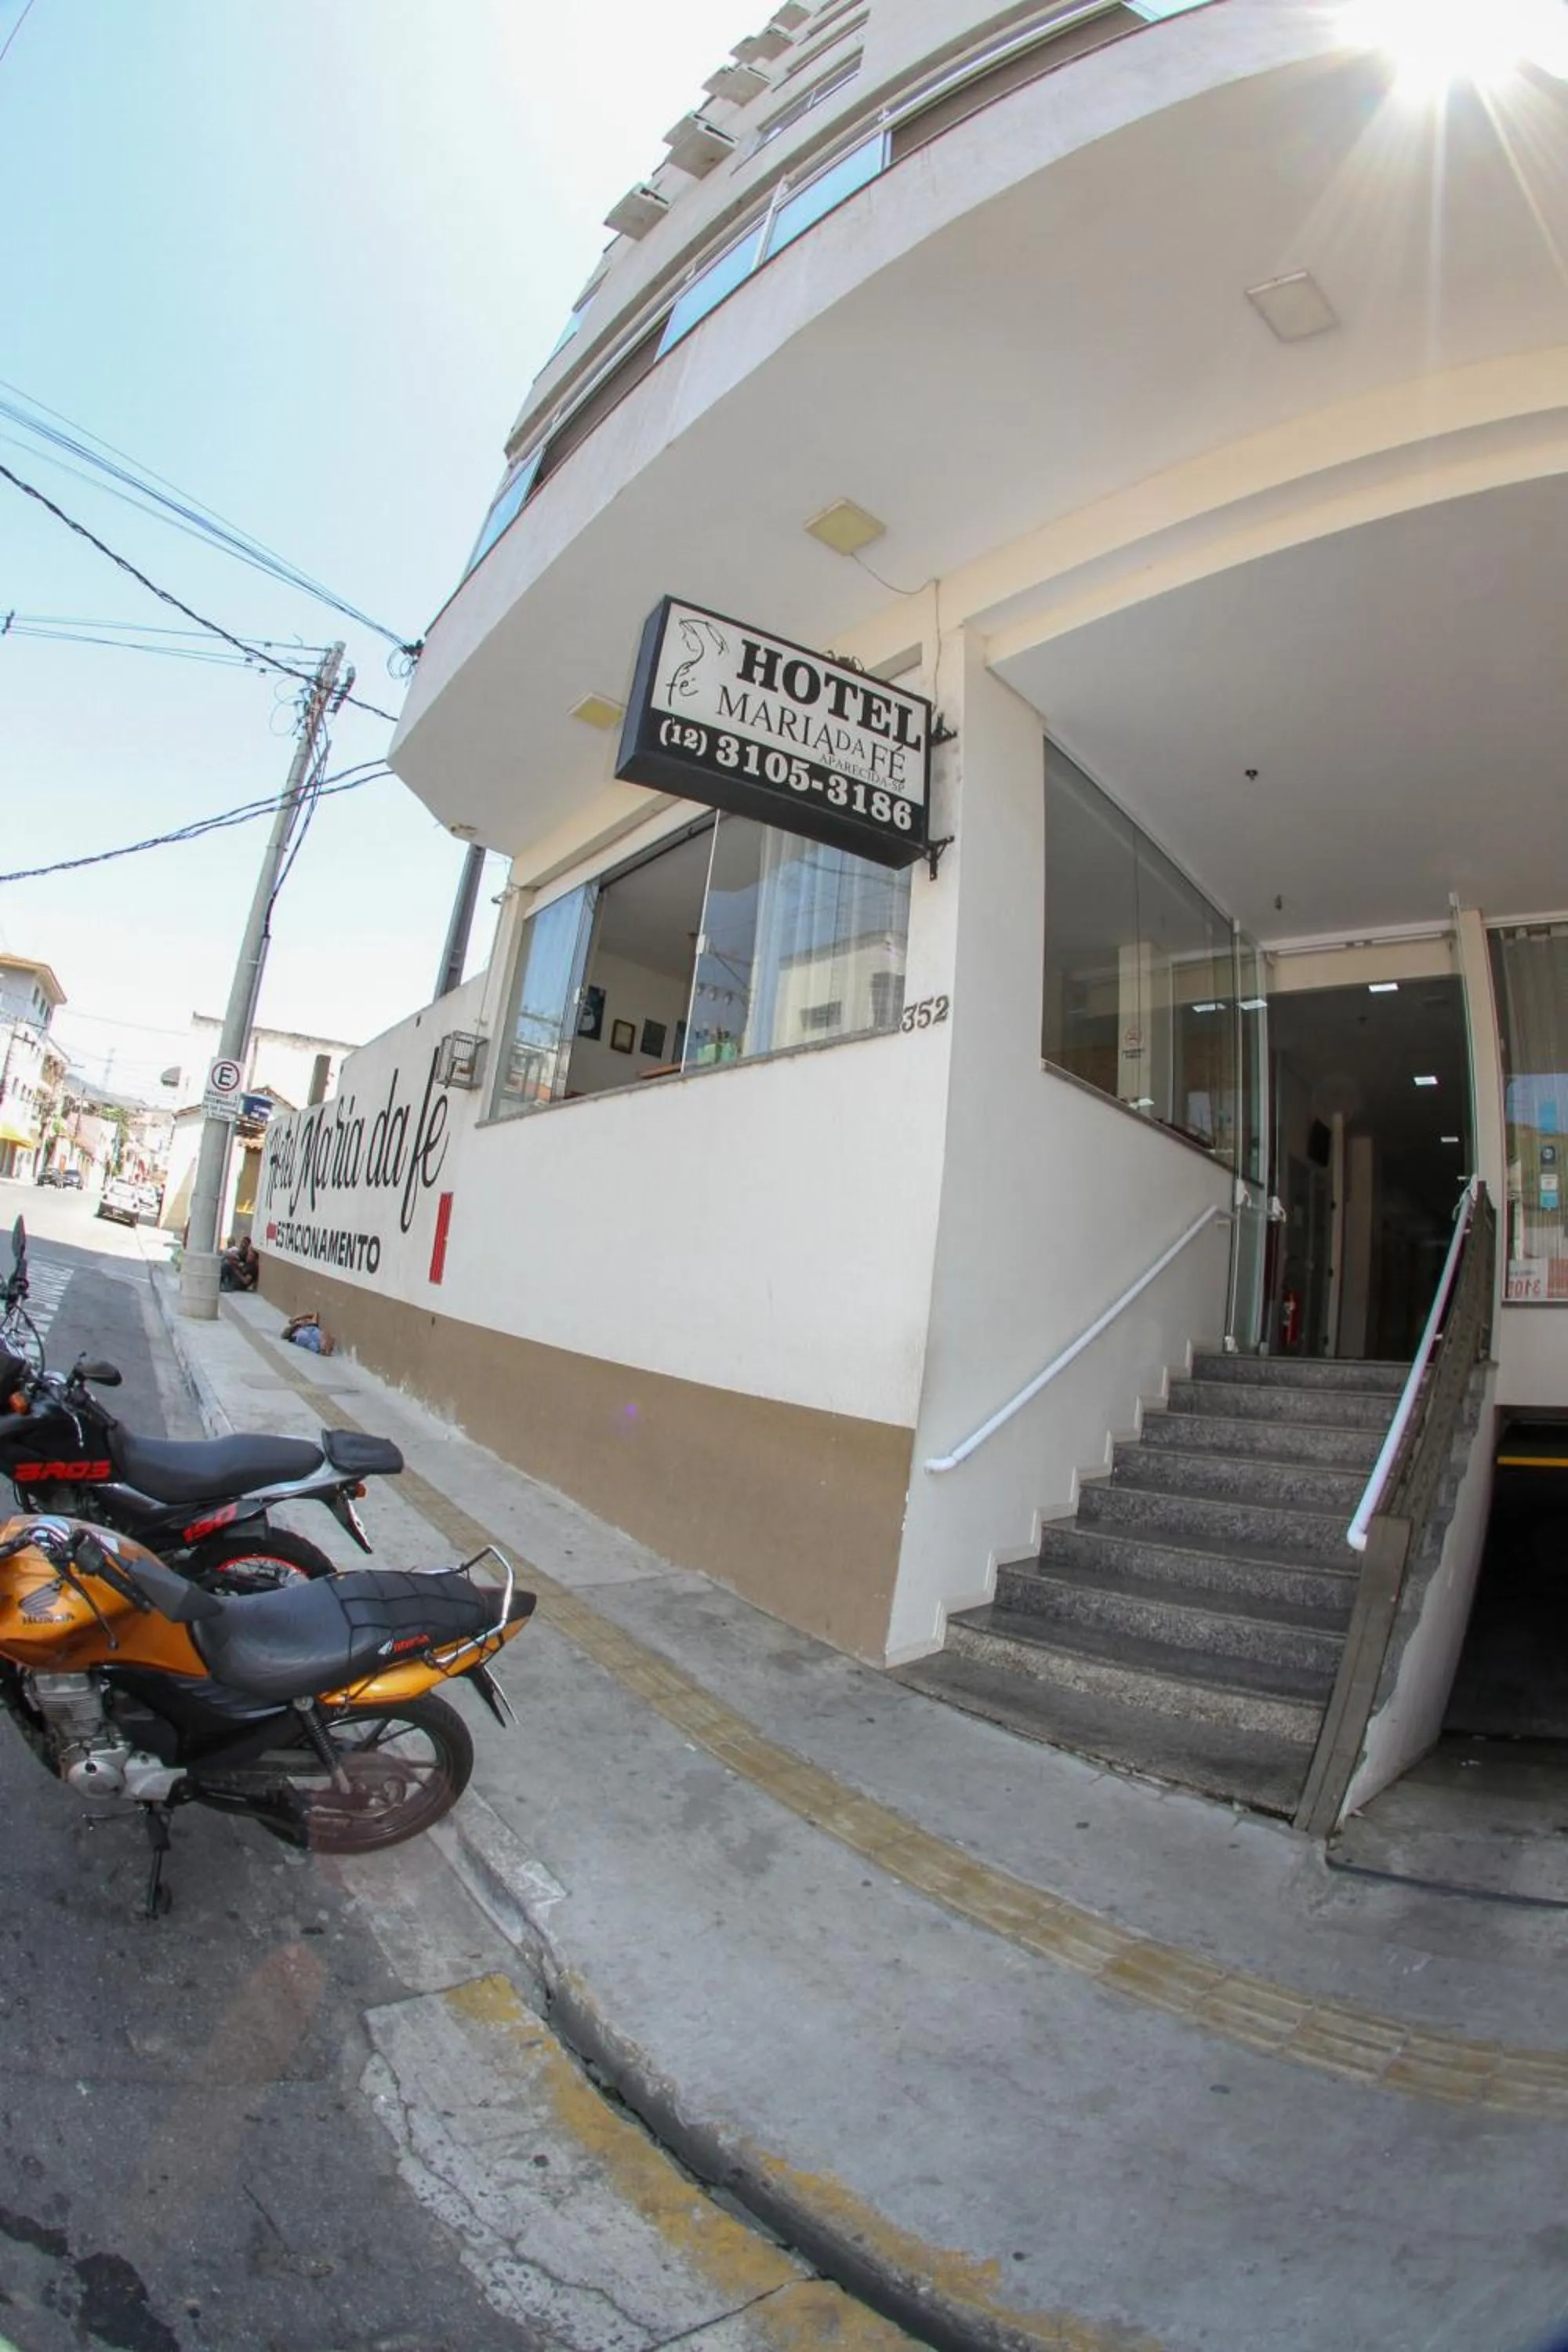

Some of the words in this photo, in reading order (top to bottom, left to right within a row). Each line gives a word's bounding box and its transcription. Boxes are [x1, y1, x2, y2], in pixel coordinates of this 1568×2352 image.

[736, 638, 925, 753] HOTEL
[659, 717, 708, 757] (12)
[715, 734, 913, 831] 3105-3186
[901, 994, 949, 1033] 352
[218, 1066, 233, 1087] E
[289, 1094, 365, 1218] Maria
[366, 1067, 409, 1189] da
[275, 1220, 381, 1274] ESTACIONAMENTO
[14, 1460, 111, 1481] BROS
